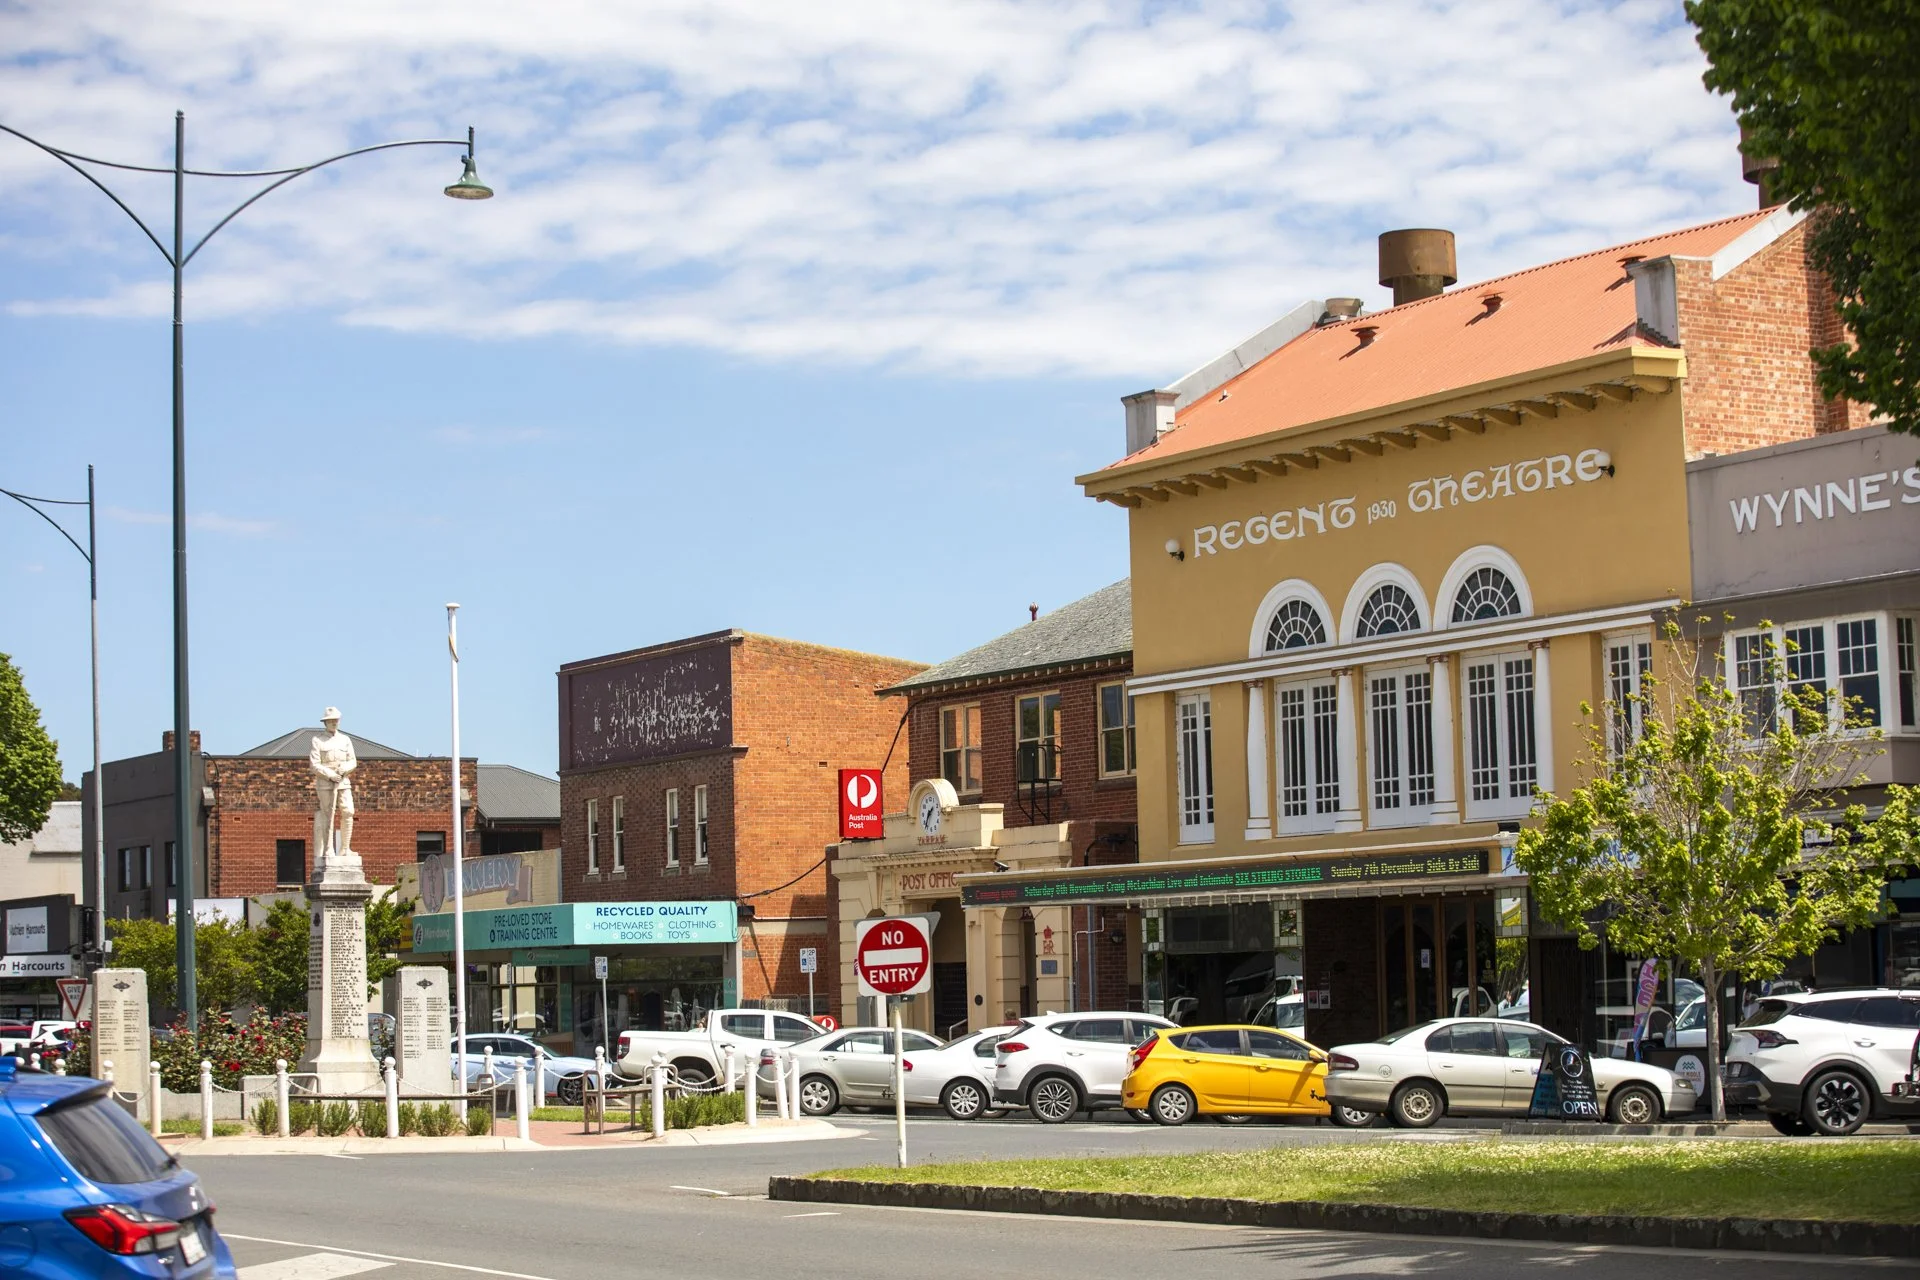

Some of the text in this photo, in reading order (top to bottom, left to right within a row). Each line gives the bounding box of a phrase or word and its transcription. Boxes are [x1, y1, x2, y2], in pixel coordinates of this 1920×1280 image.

[1193, 448, 1606, 558] REGENT 1930 THEATRE
[1730, 467, 1920, 534] WYNNE'S
[848, 821, 864, 829] Post
[1331, 863, 1362, 879] Sunday
[1364, 861, 1379, 876] 7th
[1381, 859, 1424, 875] December
[1426, 857, 1447, 873] Side
[1449, 857, 1460, 872] By
[902, 874, 925, 890] POST
[1167, 876, 1182, 888] Live
[1184, 873, 1199, 887] and
[1200, 872, 1234, 886] Intimate
[1285, 866, 1322, 882] STORIES
[494, 912, 552, 927] PRE-LOVED STORE
[596, 906, 708, 917] RECYCLED QUALITY
[593, 920, 716, 930] HOMEWARES CLOTHING
[497, 926, 558, 942] TRAINING CENTRE
[620, 930, 691, 940] BOOKS TOYS
[882, 930, 904, 946] NO
[12, 961, 65, 971] Harcourts
[869, 967, 919, 984] ENTRY
[1563, 1101, 1598, 1115] OPEN
